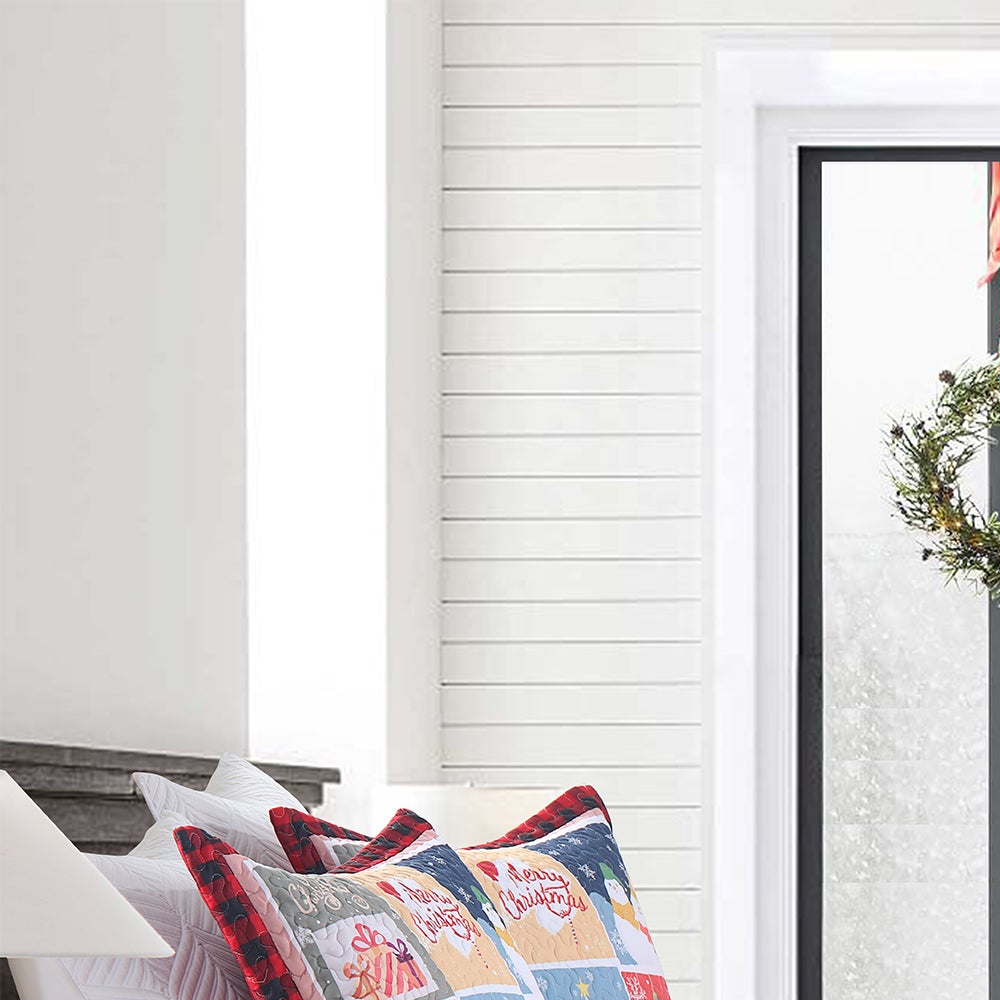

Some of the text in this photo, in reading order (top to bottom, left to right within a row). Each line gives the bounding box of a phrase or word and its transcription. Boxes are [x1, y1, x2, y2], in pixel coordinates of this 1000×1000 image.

[506, 862, 569, 894] Merry
[400, 882, 460, 913] Merry
[499, 883, 588, 920] Christmas
[410, 906, 481, 944] Christmas
